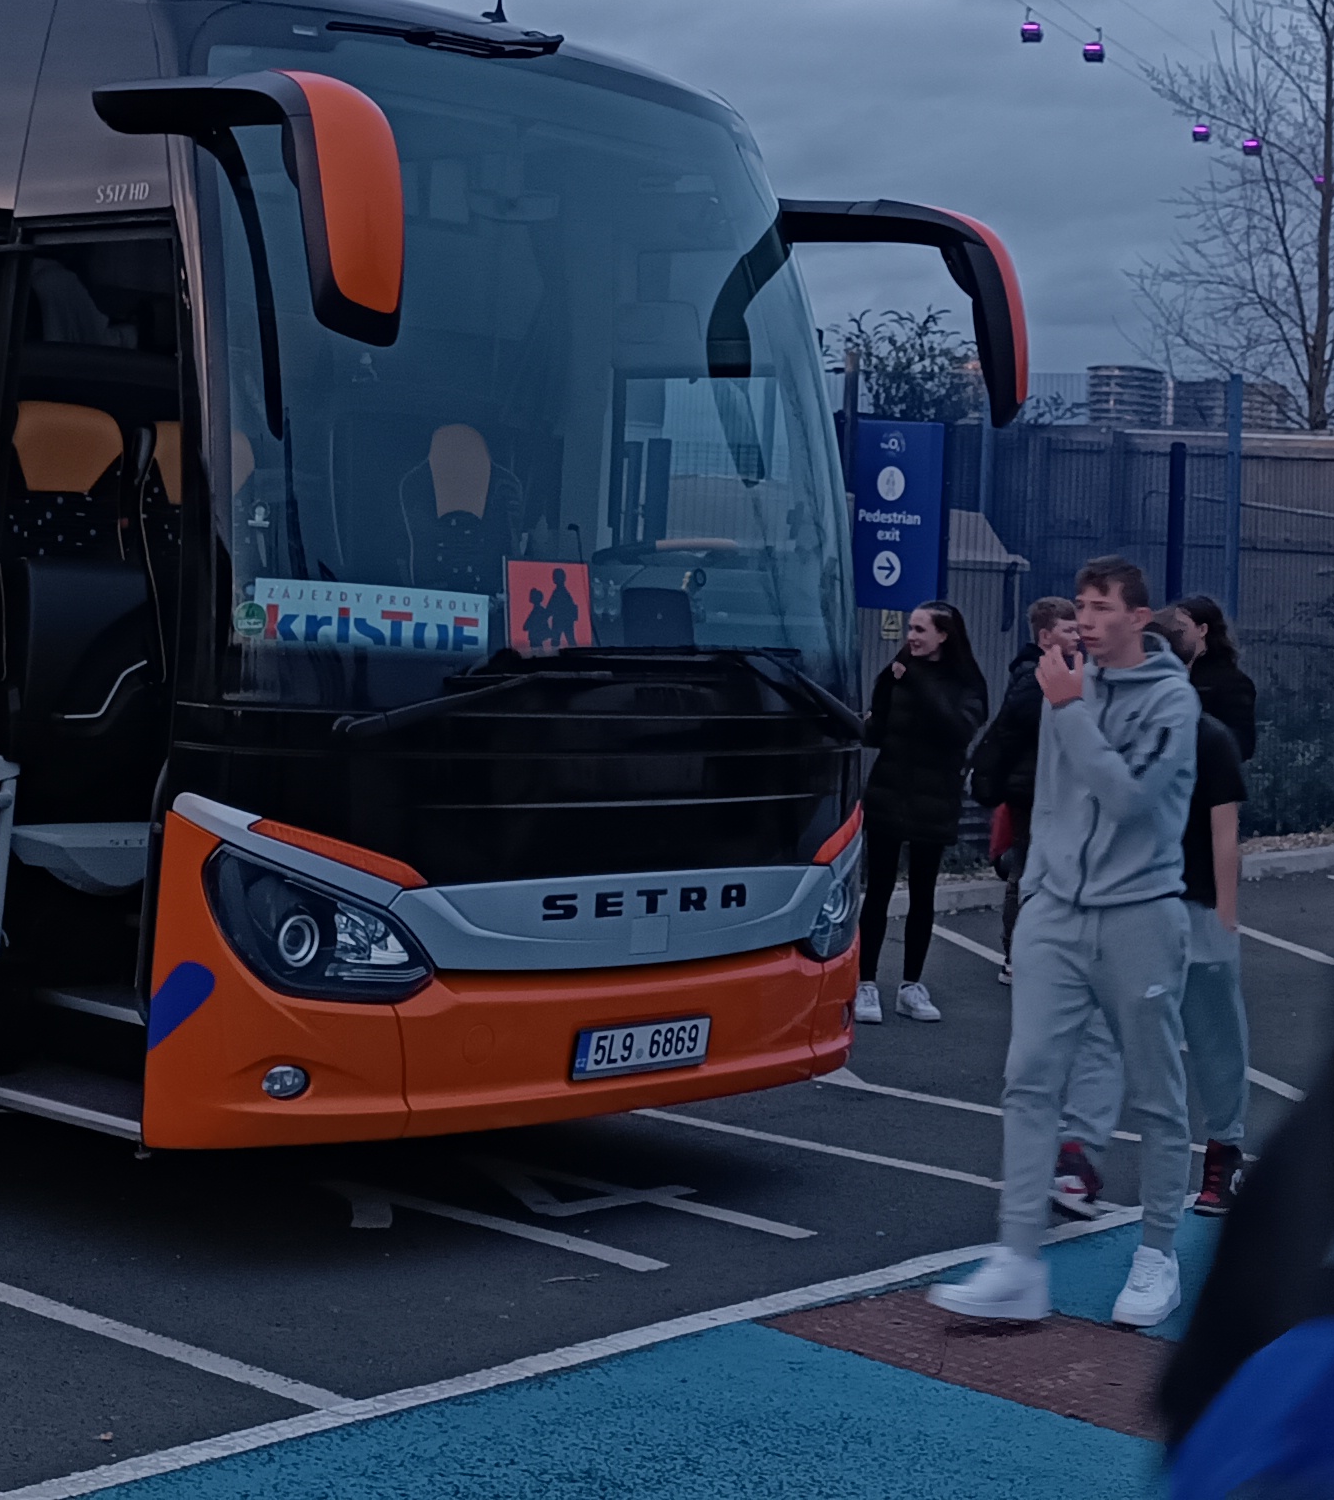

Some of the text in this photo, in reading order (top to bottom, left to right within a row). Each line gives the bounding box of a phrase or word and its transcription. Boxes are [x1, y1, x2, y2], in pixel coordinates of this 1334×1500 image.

[129, 181, 150, 201] HD
[858, 508, 922, 526] Pedestrian
[876, 527, 901, 542] exit
[267, 586, 481, 614] ZÁJEZDY PRO ŠKOLY
[542, 882, 747, 921] SETRA
[593, 1023, 700, 1066] 5L9 6869
